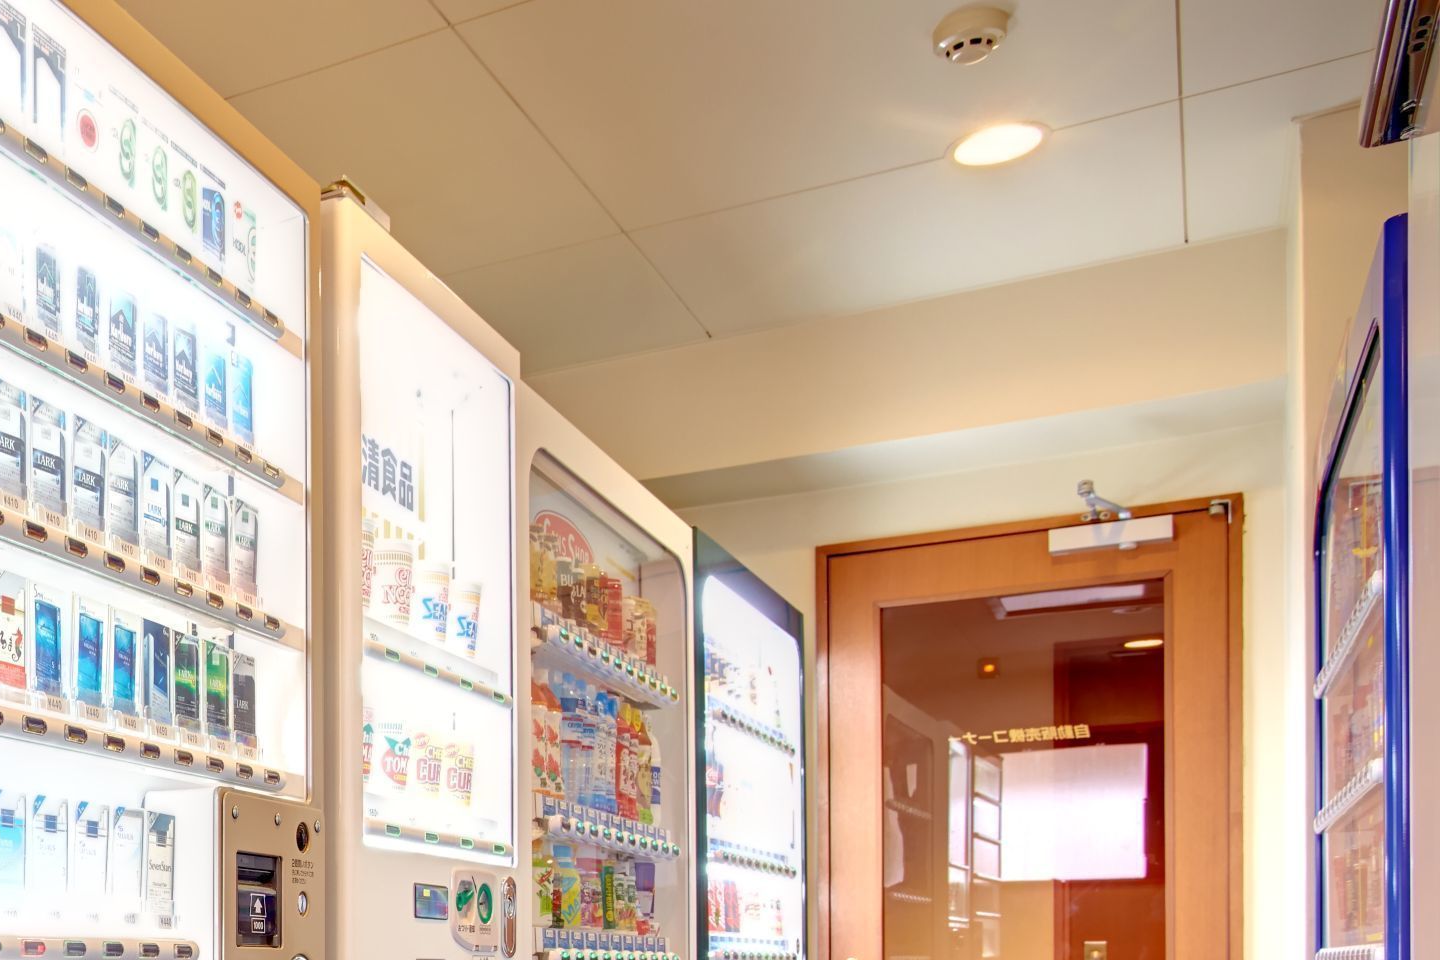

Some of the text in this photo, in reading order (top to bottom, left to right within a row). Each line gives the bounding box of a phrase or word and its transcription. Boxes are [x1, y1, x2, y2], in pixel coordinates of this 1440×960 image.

[36, 454, 56, 470] LARK
[78, 470, 96, 487] LARK
[3, 495, 19, 509] ¥410
[45, 512, 60, 527] ¥410
[84, 527, 98, 541] ¥410
[178, 519, 193, 536] LARK
[253, 921, 264, 930] 1000
